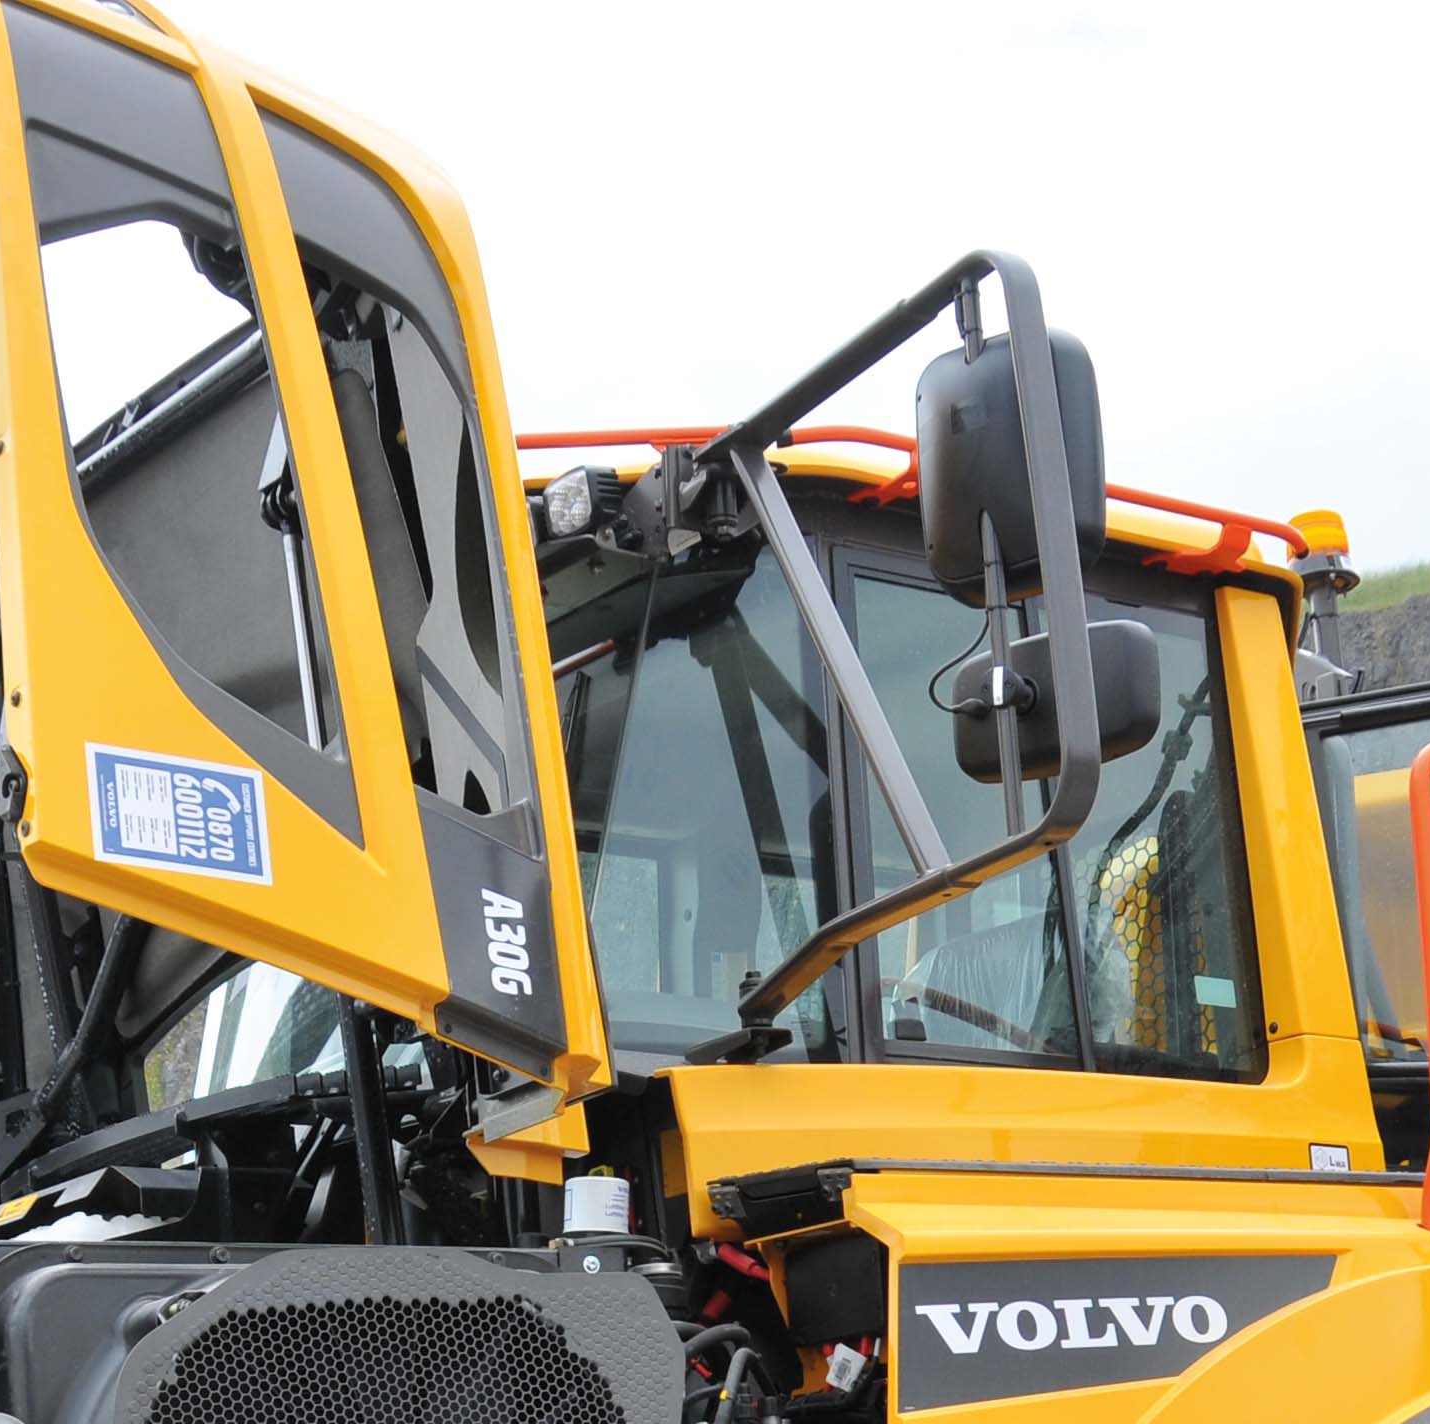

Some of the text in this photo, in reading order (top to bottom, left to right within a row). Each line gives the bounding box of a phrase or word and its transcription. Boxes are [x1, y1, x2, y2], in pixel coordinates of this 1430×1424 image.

[106, 781, 118, 828] VOLVO
[173, 772, 208, 859] 6001112
[244, 813, 255, 844] SUPPORT
[206, 807, 236, 862] 0870
[480, 887, 533, 996] A30G
[914, 1294, 1229, 1354] VOLVO
